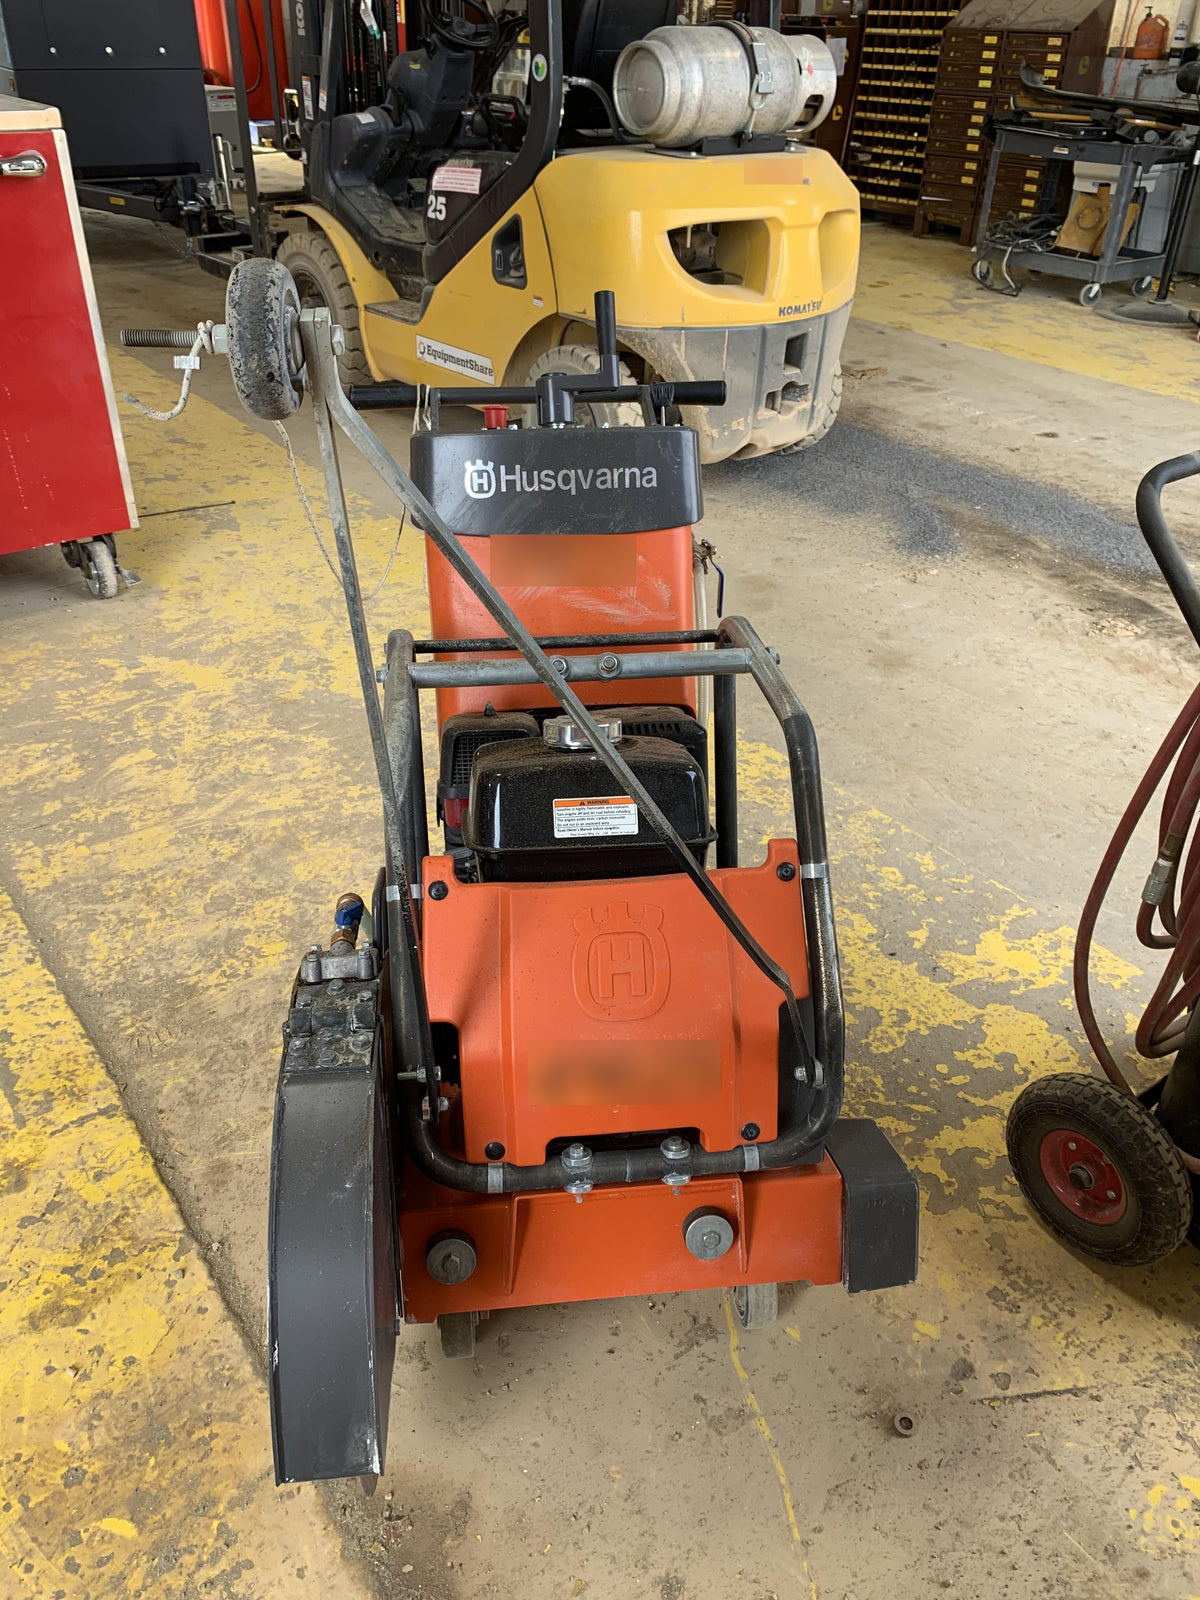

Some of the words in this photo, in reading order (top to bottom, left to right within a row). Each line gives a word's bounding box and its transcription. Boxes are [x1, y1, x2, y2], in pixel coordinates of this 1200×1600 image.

[295, 0, 306, 36] KO
[427, 194, 447, 221] 25
[778, 300, 822, 317] KOMATSU
[426, 344, 494, 377] EquipmentShare
[499, 464, 658, 496] Husqvarna
